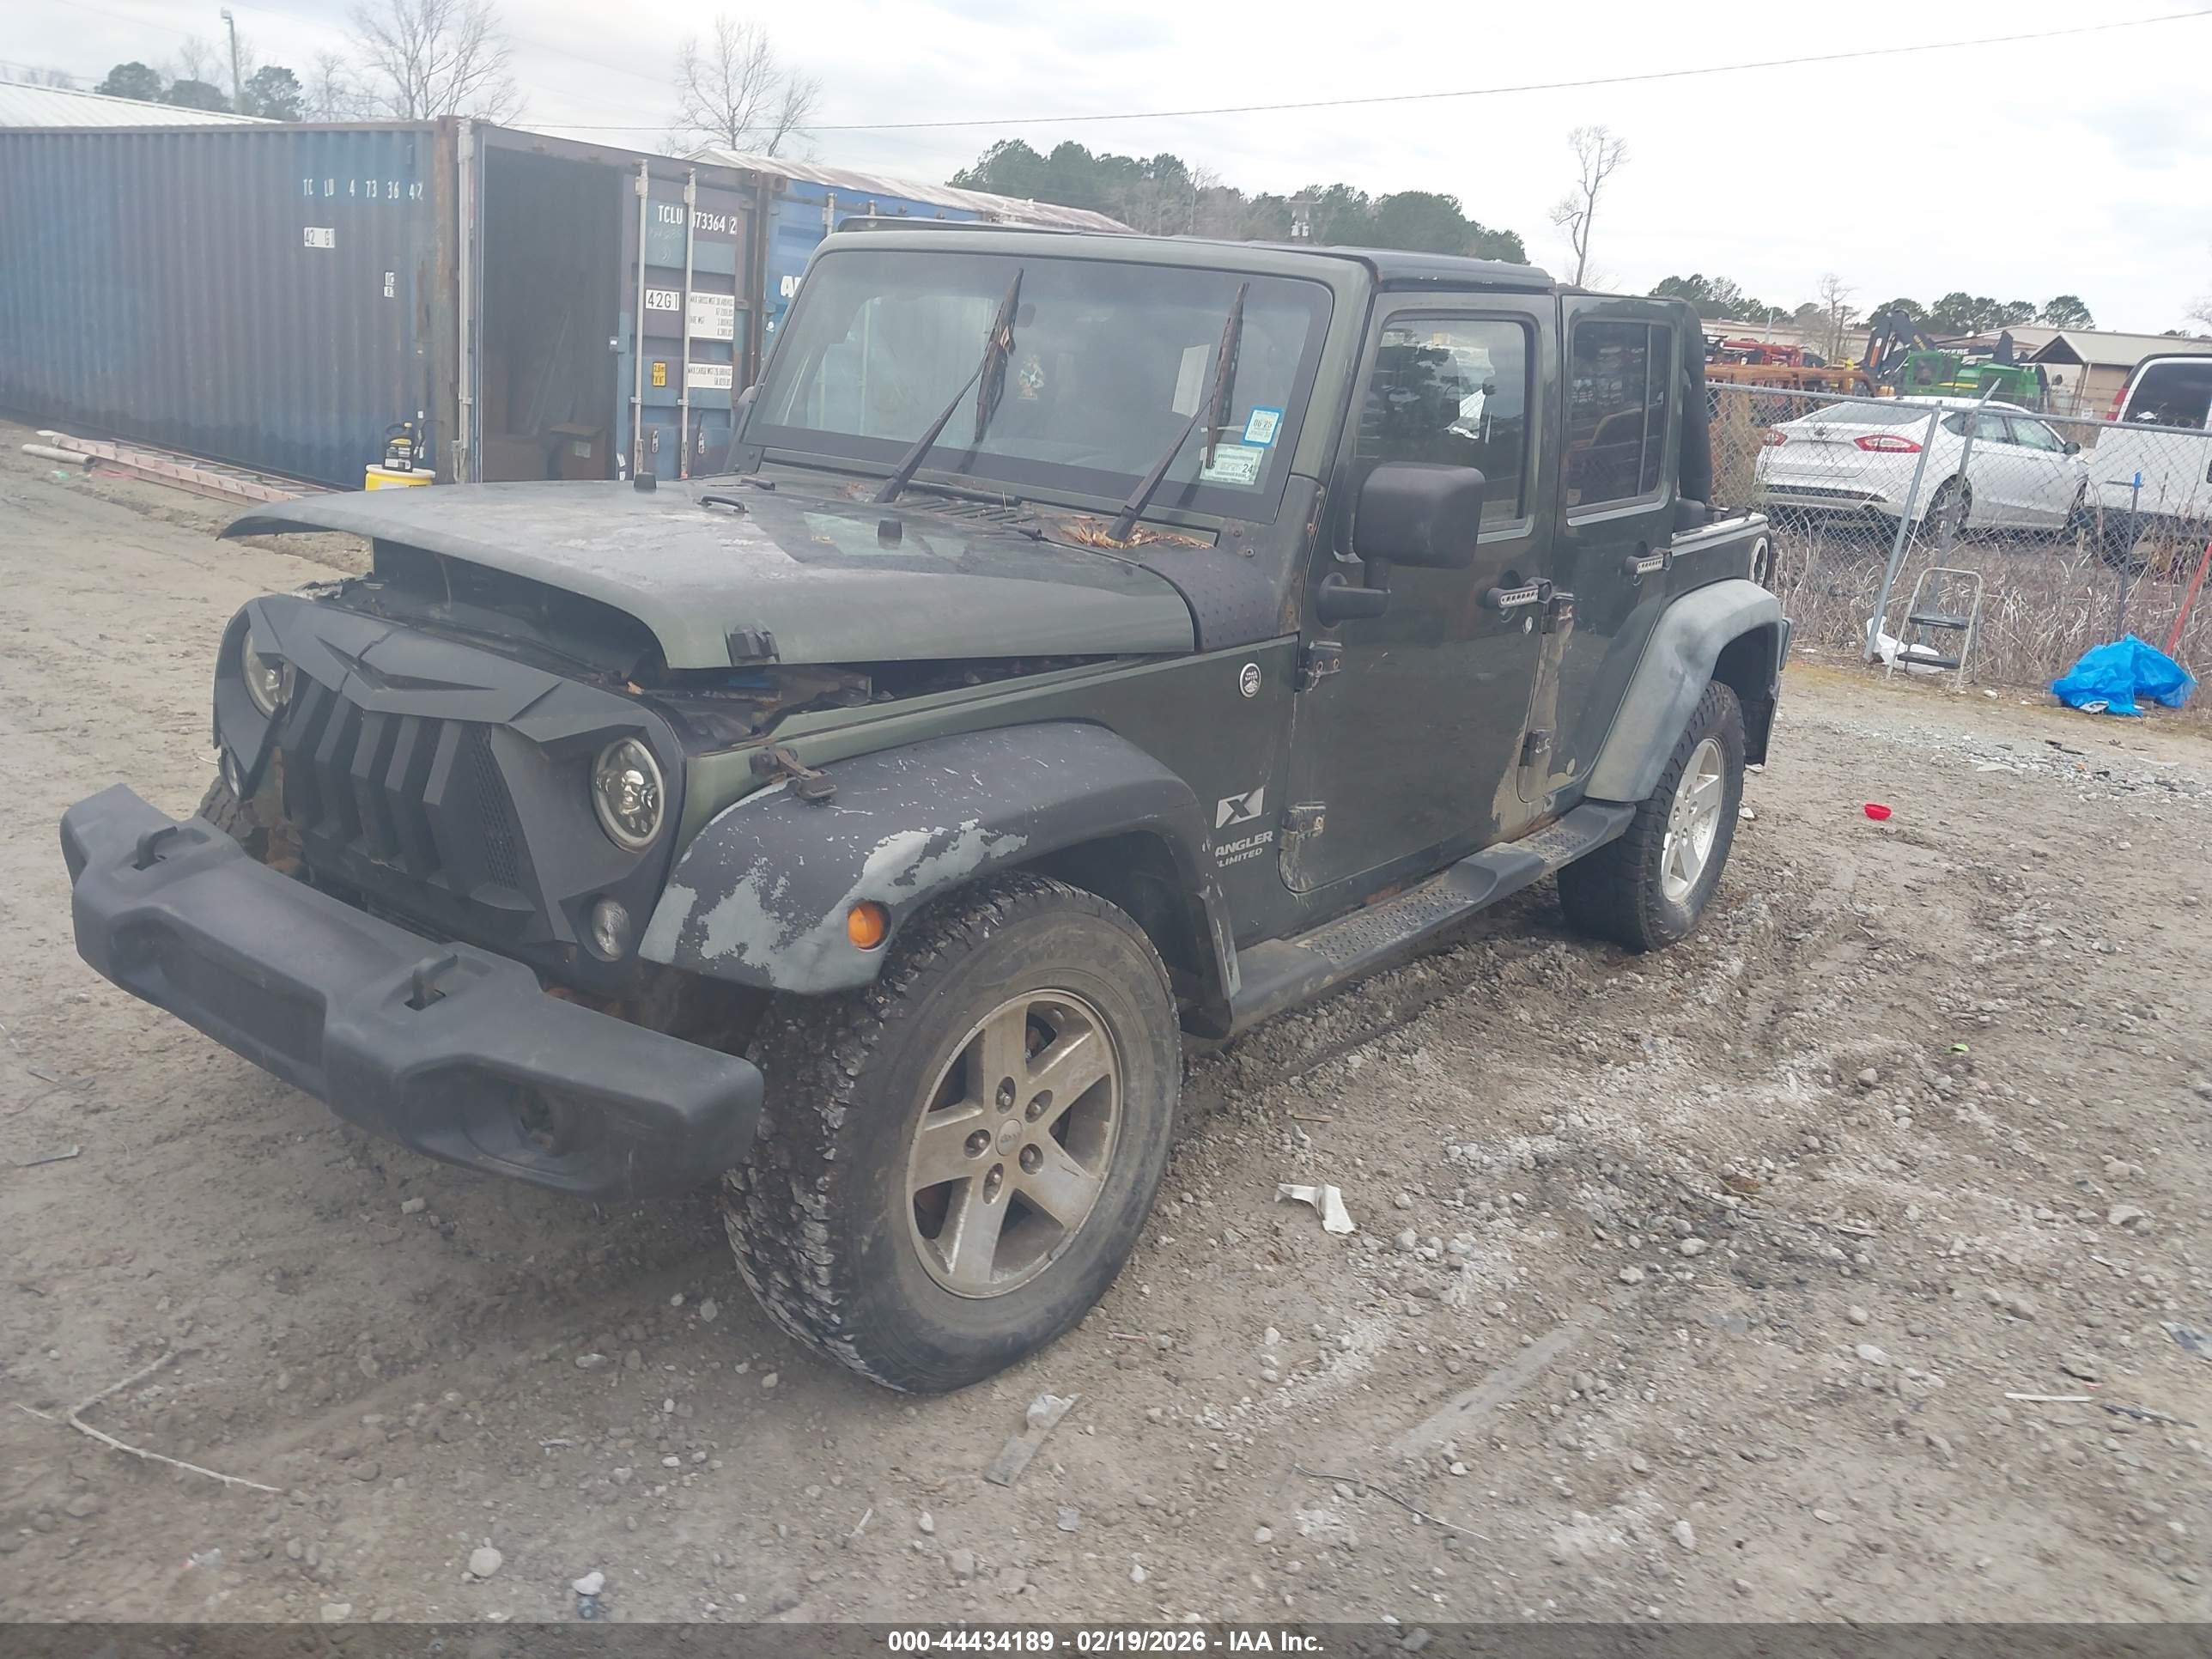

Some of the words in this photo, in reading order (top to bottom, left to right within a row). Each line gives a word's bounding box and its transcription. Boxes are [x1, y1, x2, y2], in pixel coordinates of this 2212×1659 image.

[658, 205, 684, 224] TCLU
[647, 292, 678, 309] 42G1
[1243, 464, 1253, 473] 24
